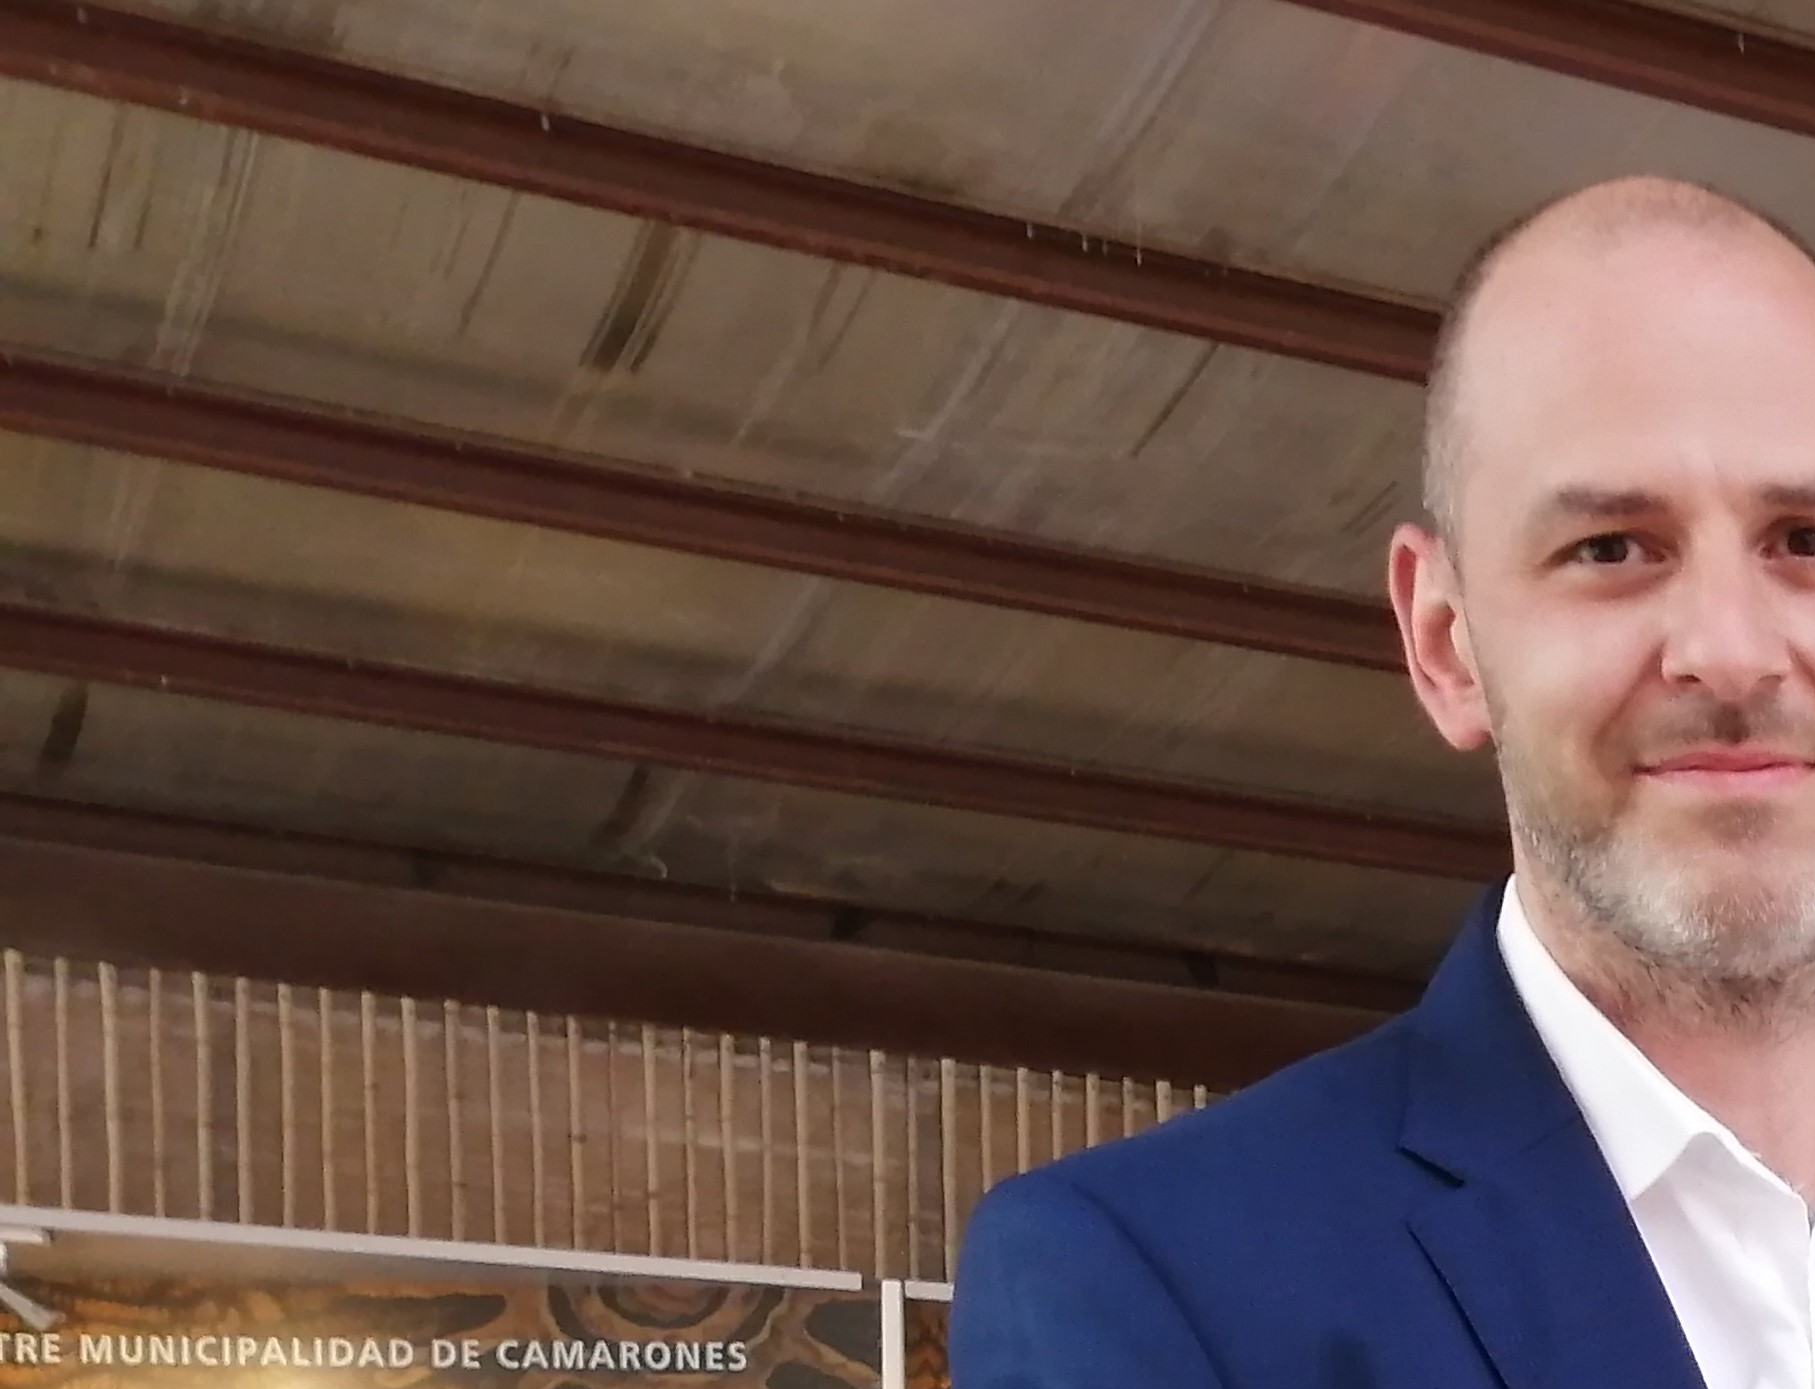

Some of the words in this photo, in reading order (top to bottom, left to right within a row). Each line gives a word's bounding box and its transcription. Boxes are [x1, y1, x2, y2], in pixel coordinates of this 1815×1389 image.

[80, 1334, 414, 1368] MUNICIPALIDAD
[430, 1338, 481, 1369] DE
[495, 1340, 748, 1372] CAMARONES
